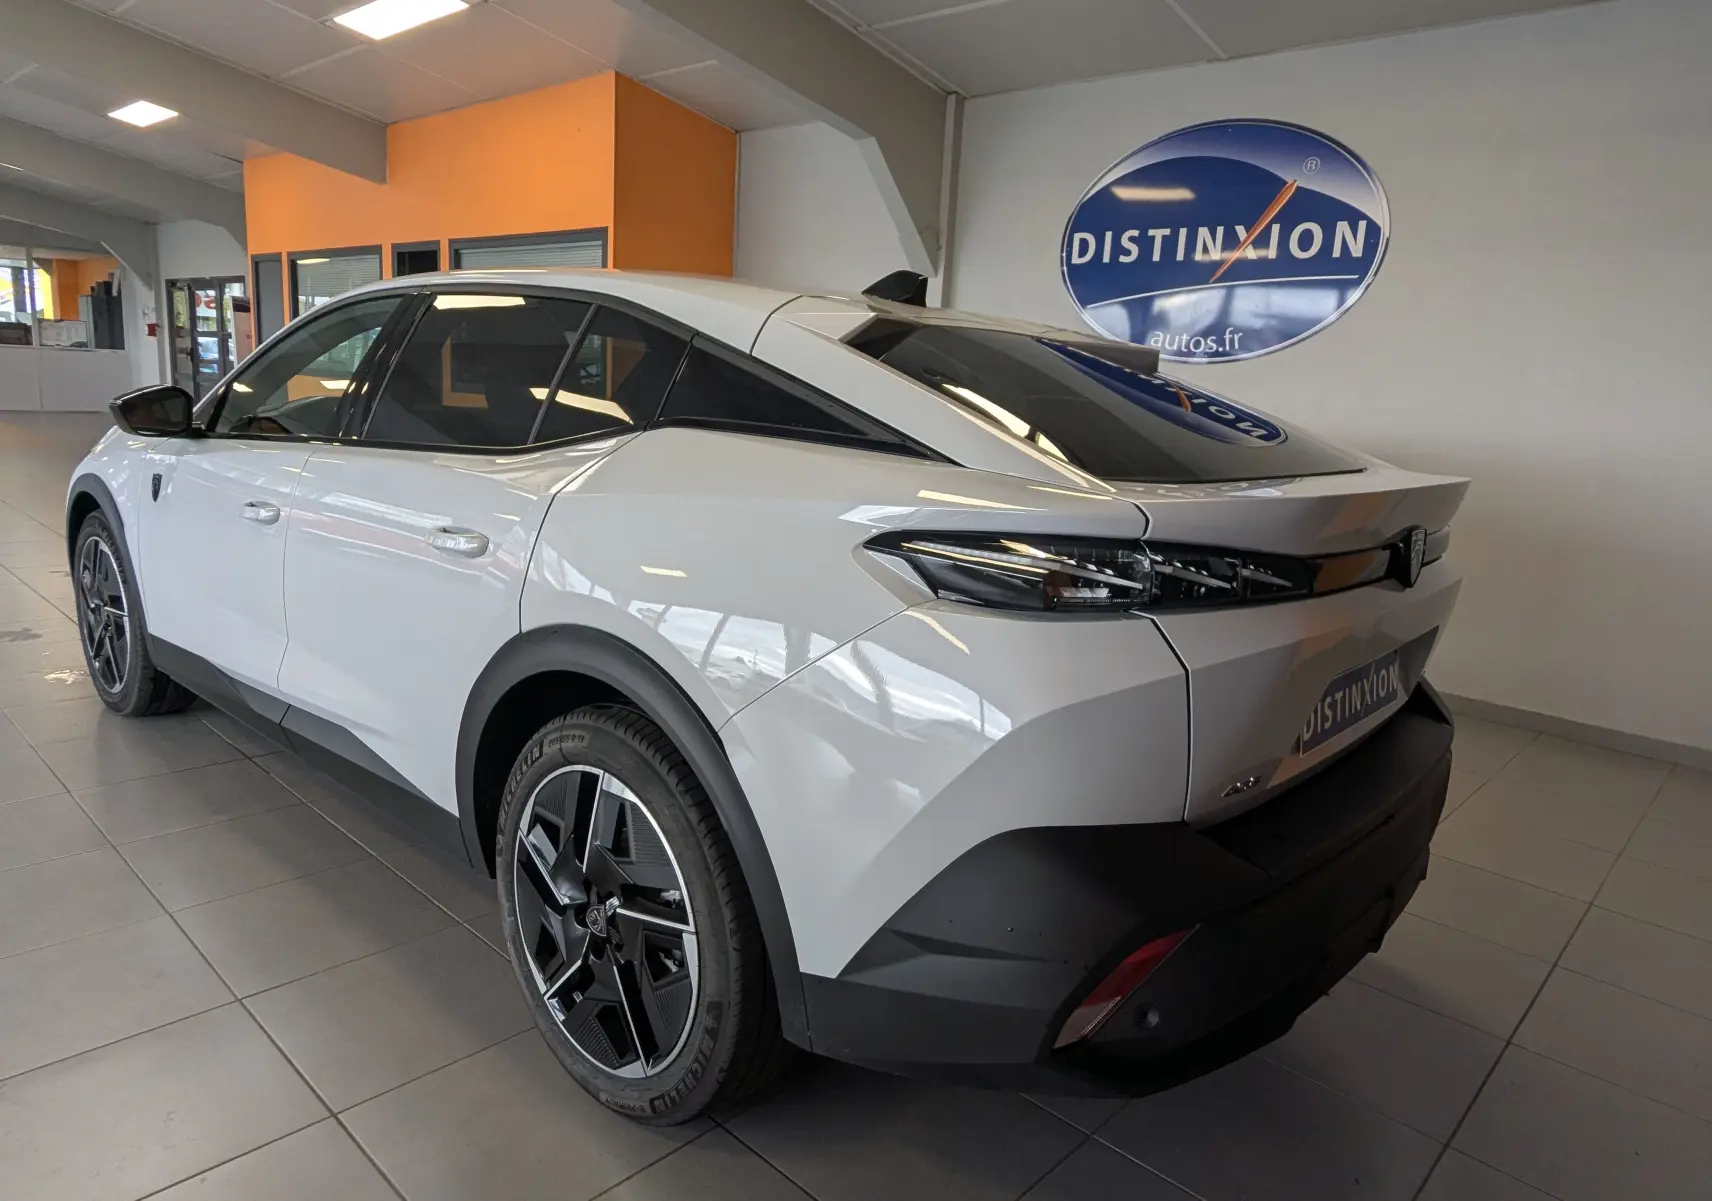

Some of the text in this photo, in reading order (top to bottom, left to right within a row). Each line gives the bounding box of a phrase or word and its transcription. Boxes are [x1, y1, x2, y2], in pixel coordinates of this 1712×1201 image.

[1071, 220, 1367, 264] DISTINXION
[1150, 327, 1243, 353] autos.fr
[1303, 662, 1398, 742] DISTINXION
[499, 743, 541, 830] MICHELIN
[654, 1034, 715, 1114] MICHELIN
